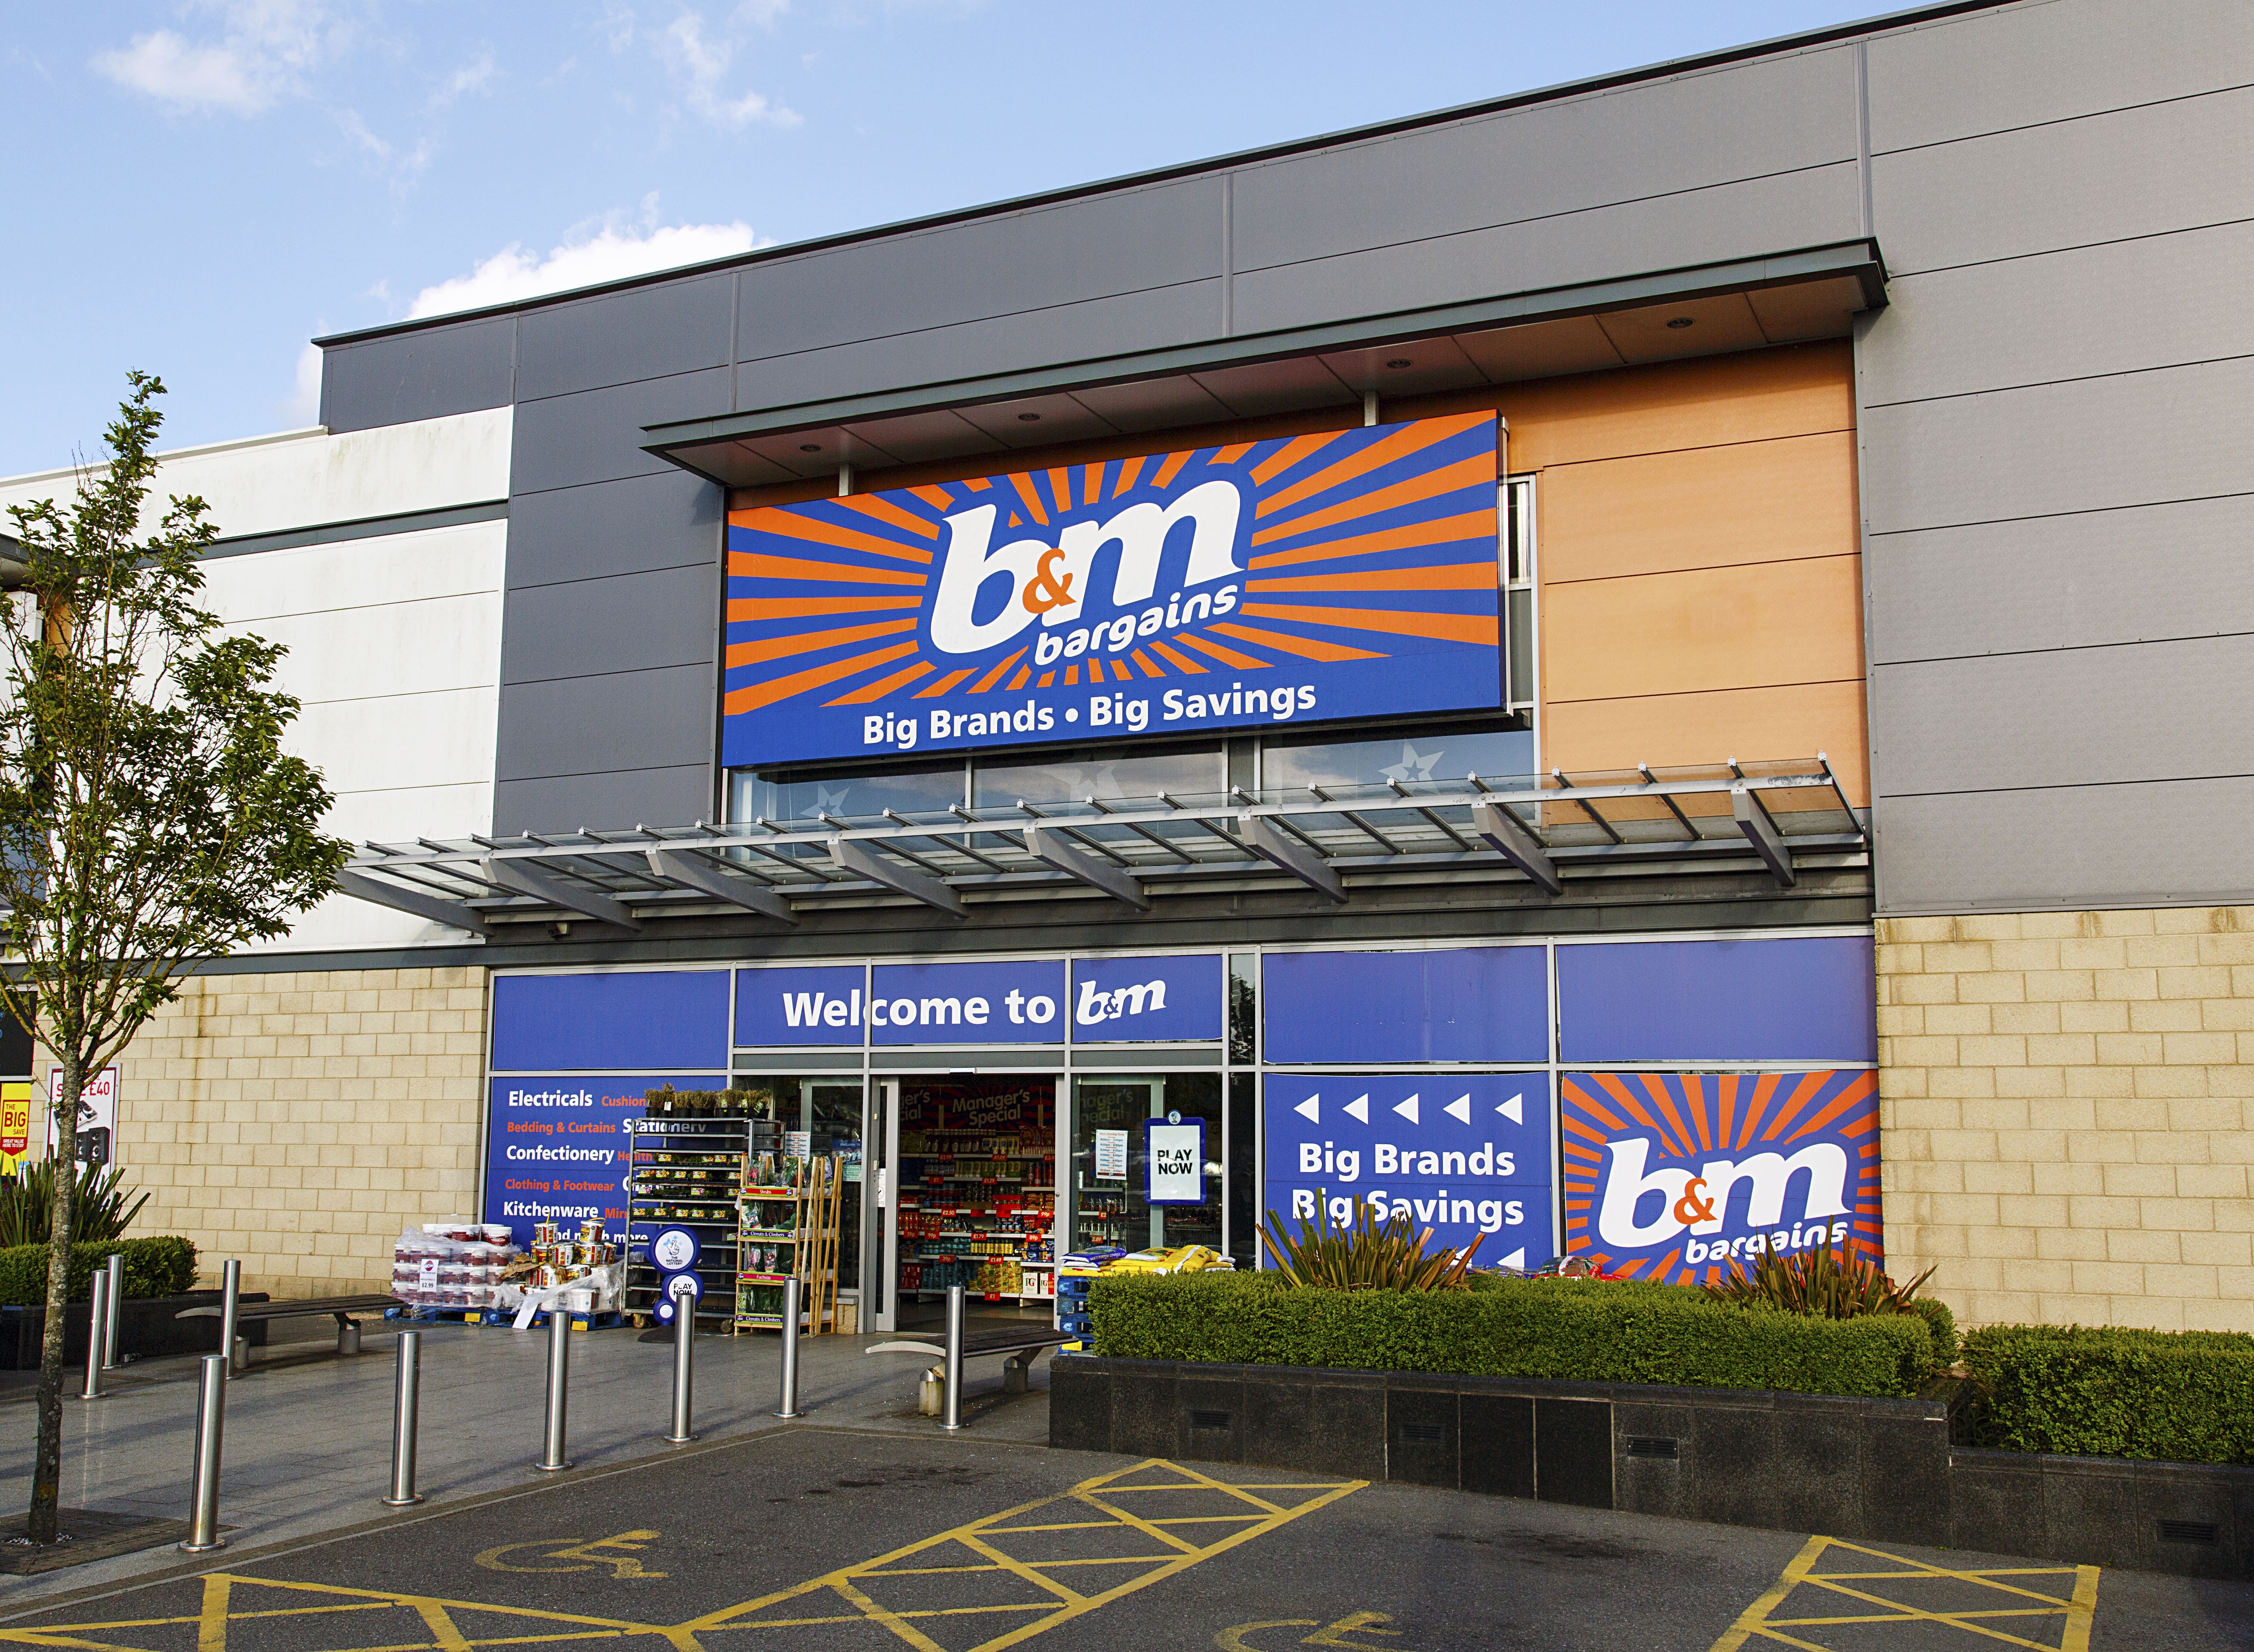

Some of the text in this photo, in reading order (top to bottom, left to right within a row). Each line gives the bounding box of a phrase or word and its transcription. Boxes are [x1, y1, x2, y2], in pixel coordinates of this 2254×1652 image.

[930, 481, 1245, 653] b&m
[1034, 585, 1238, 665] bargains
[864, 682, 1316, 749] Big Brands Big Savings
[783, 980, 1167, 1026] Welcome to b&m
[90, 1082, 110, 1095] £40
[509, 1090, 647, 1106] Electricals Cushion
[952, 1089, 1030, 1113] Manager's
[4, 1112, 26, 1127] BIG
[969, 1104, 1021, 1128] Special
[507, 1122, 553, 1135] Bedding
[557, 1122, 565, 1133] &
[568, 1122, 616, 1133] Curtains
[506, 1145, 614, 1165] Confectionery
[1158, 1150, 1192, 1161] PLAY
[1300, 1141, 1515, 1182] Big Brands
[1158, 1162, 1192, 1174] NOW
[505, 1179, 549, 1192] Clothing
[553, 1180, 560, 1190] &
[564, 1180, 614, 1191] Footwear
[1599, 1137, 1853, 1248] b&m
[503, 1202, 599, 1218] Kitchenware
[1367, 1190, 1524, 1233] Savings
[1686, 1221, 1848, 1264] bargains
